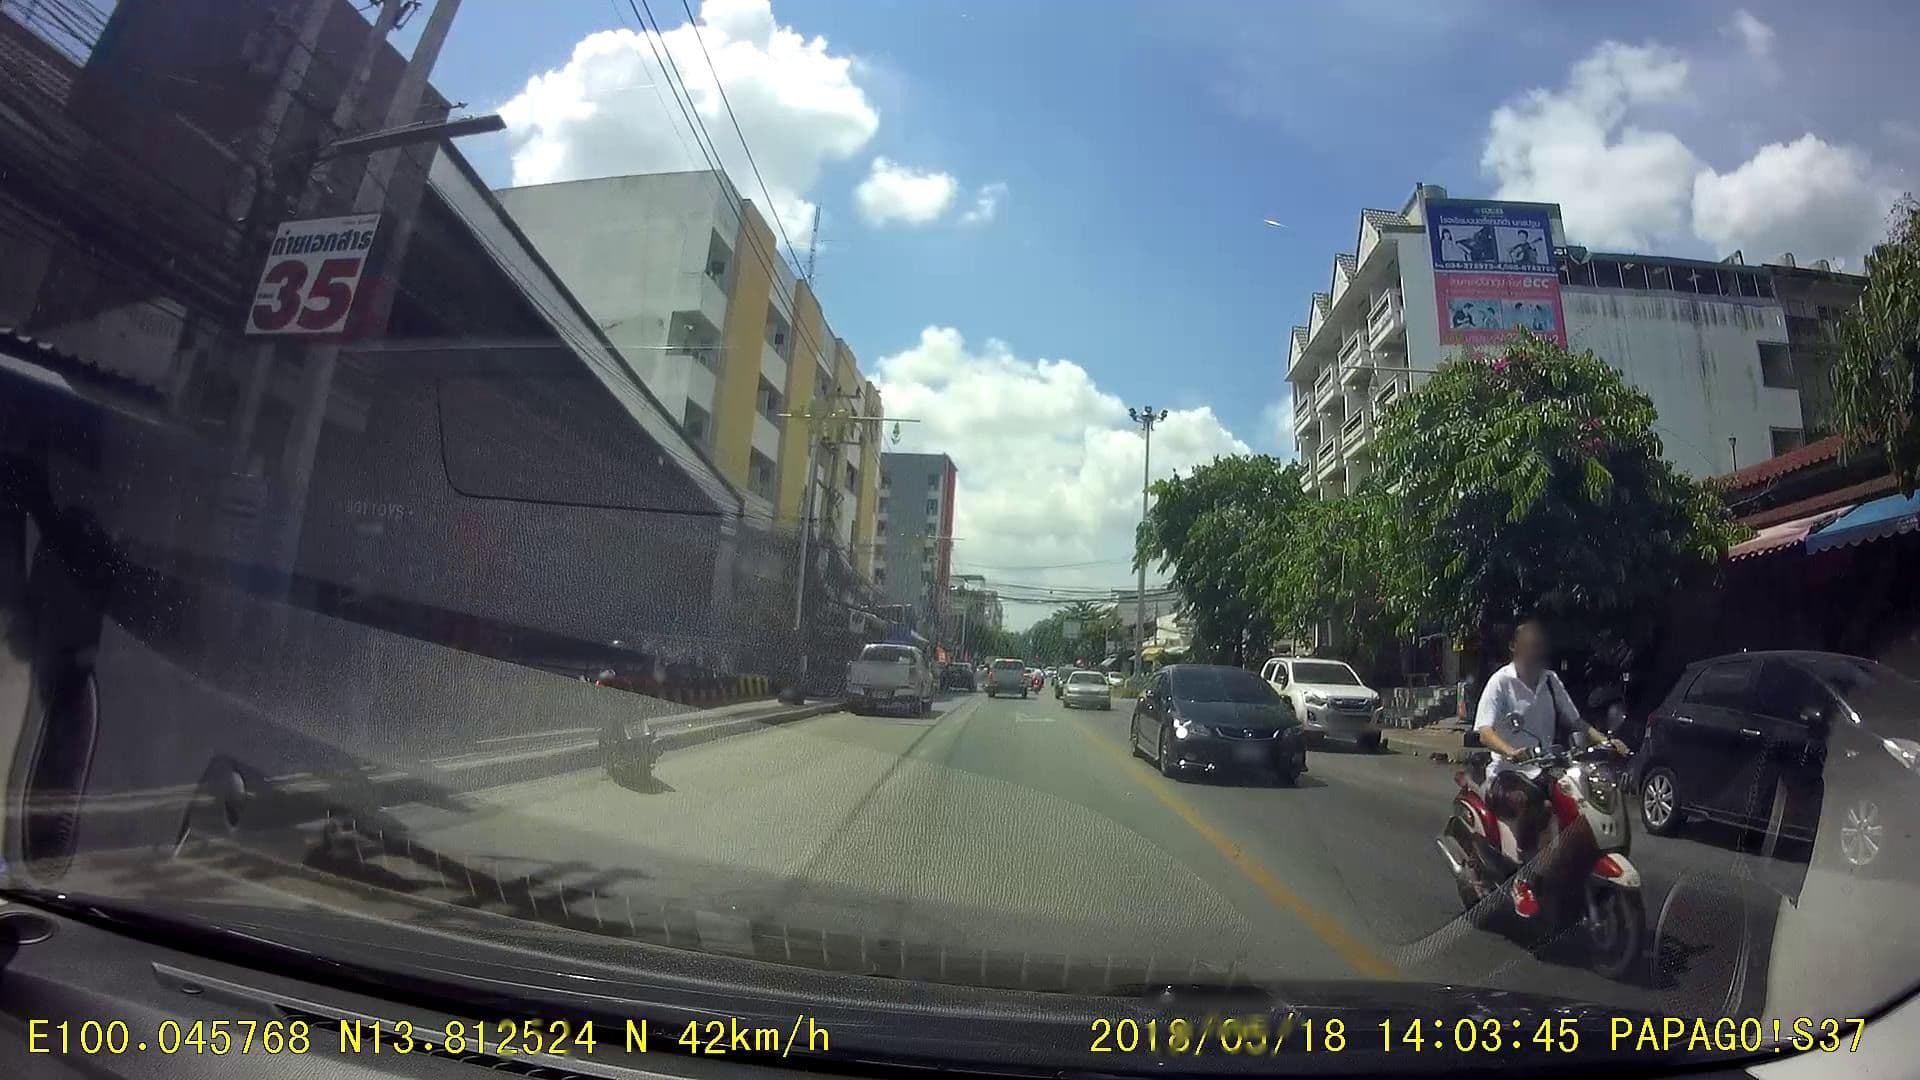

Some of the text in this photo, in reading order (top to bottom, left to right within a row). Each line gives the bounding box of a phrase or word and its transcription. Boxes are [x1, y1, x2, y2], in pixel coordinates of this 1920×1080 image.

[272, 228, 375, 257] ถ่ายเอกสาร
[252, 258, 362, 331] 35
